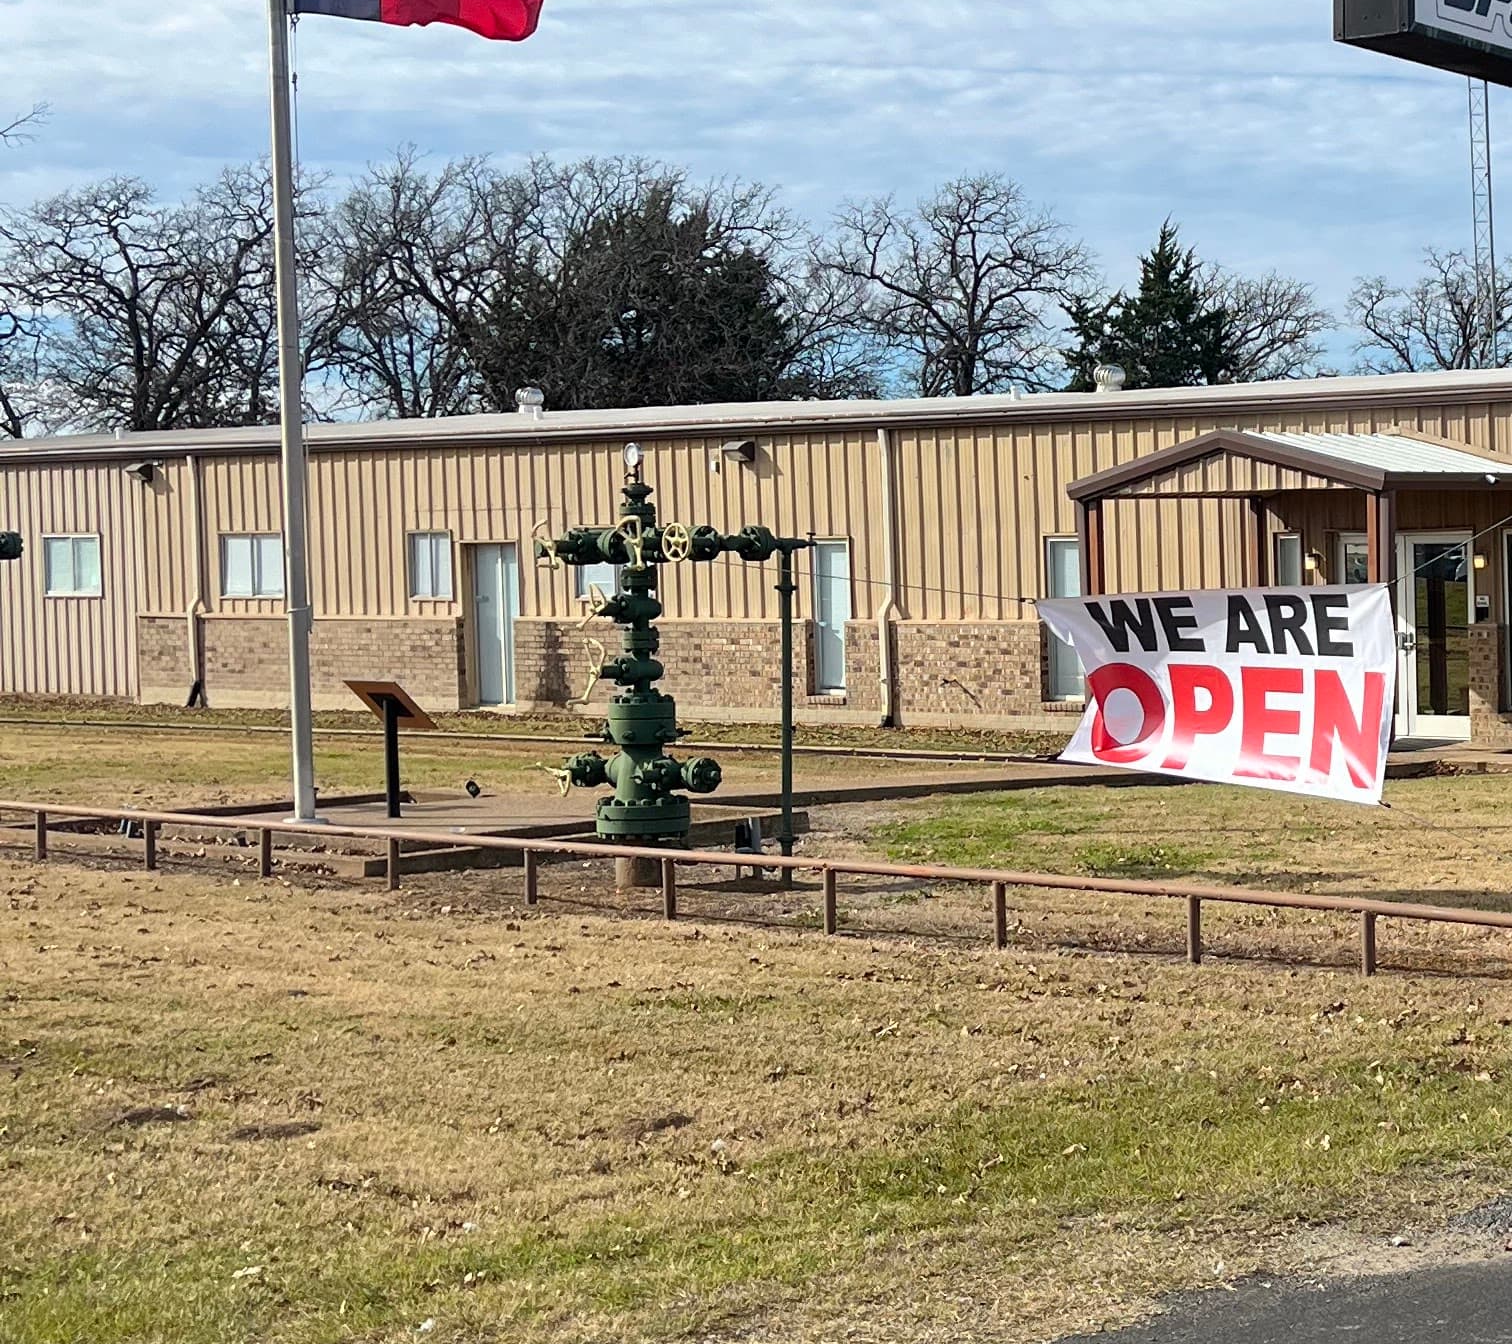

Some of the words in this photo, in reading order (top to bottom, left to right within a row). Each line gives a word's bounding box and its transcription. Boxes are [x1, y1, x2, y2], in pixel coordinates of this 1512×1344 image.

[1084, 596, 1206, 652] WE
[1225, 593, 1354, 657] ARE
[1087, 662, 1386, 789] OPEN
